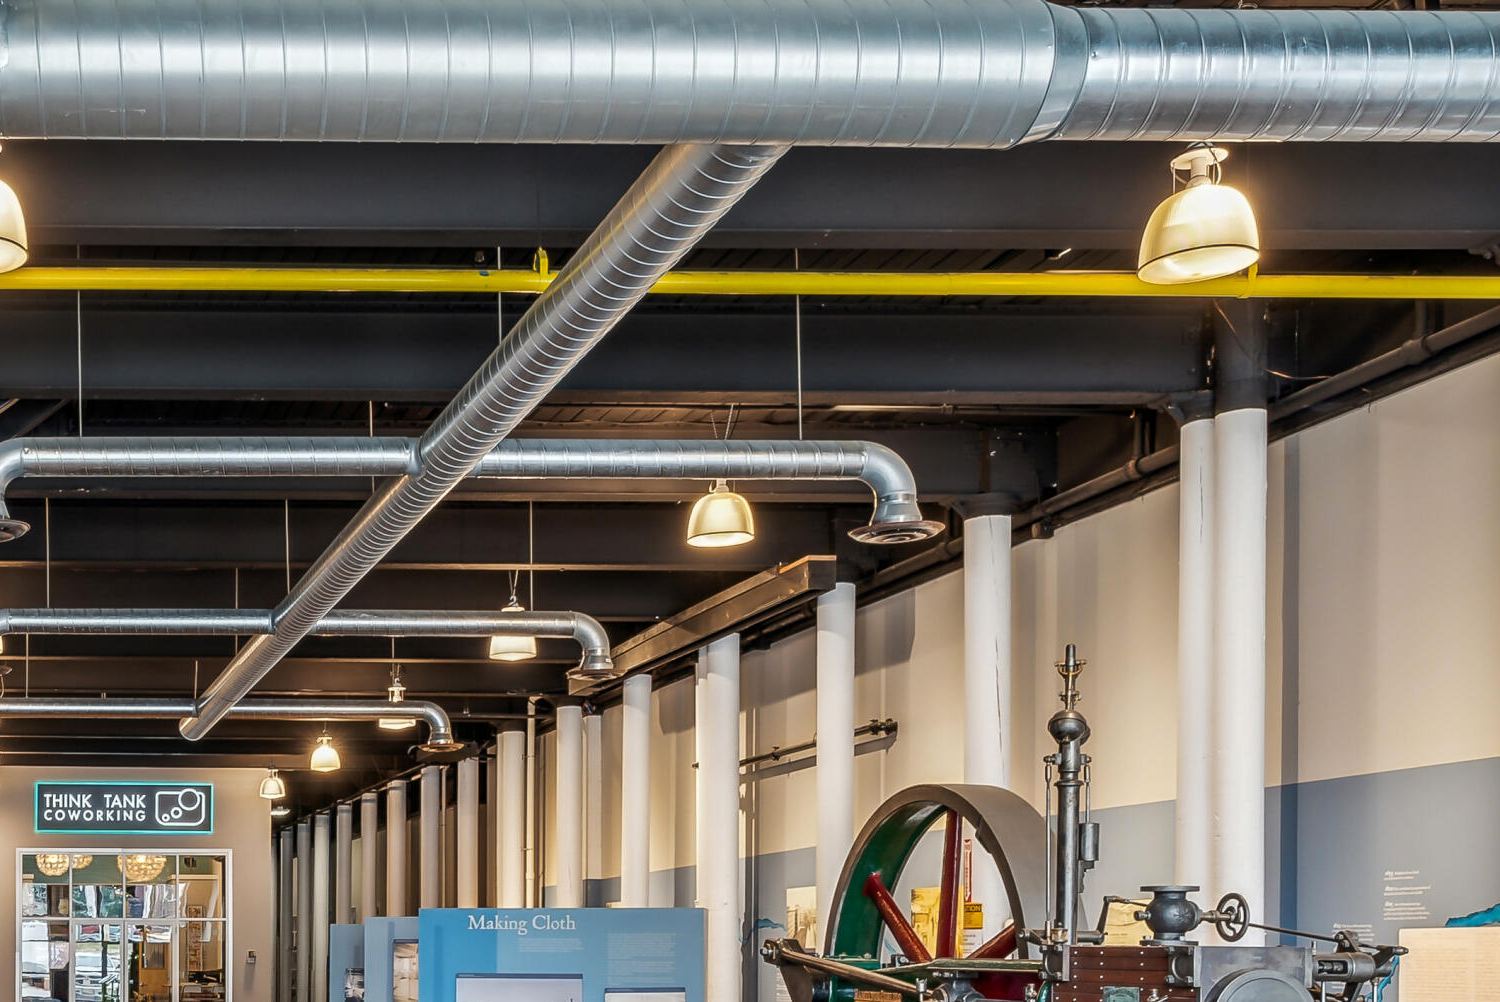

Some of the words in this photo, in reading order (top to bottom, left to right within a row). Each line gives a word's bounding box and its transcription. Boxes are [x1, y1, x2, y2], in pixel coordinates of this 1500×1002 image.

[43, 793, 92, 809] THINK
[103, 793, 147, 809] TANK
[43, 809, 147, 822] COWORKING
[467, 914, 528, 936] Making
[531, 914, 577, 931] Cloth
